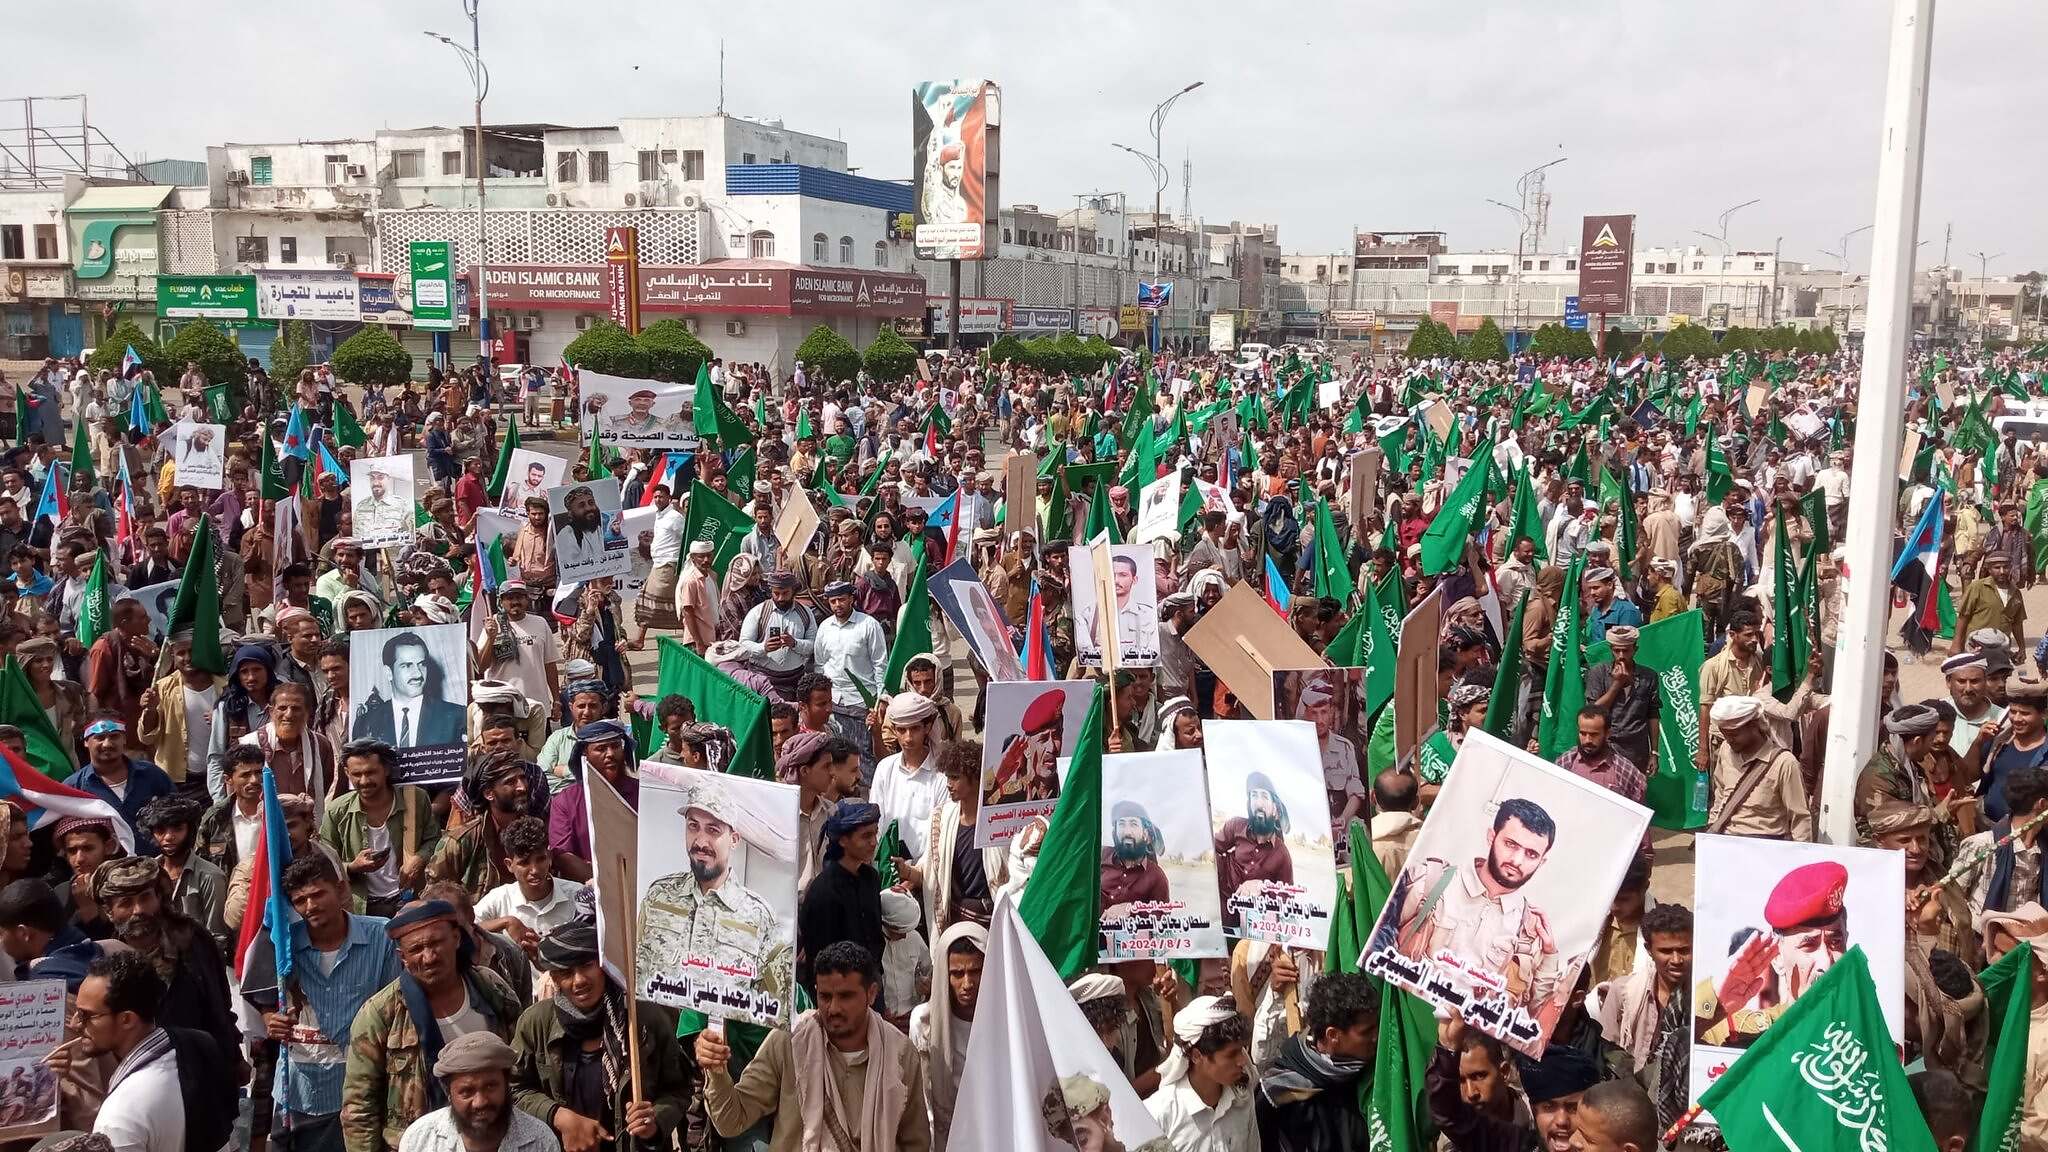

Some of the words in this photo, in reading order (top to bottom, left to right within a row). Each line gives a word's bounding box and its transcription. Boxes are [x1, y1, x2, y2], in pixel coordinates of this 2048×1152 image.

[485, 271, 515, 284] ADEN
[519, 271, 564, 285] ISLAMIC
[566, 272, 600, 285] BANK
[646, 273, 699, 290] الإسلامي
[701, 274, 735, 289] عدن
[737, 272, 772, 291] بنك
[795, 277, 812, 290] ADEN
[813, 279, 836, 292] ISLAMIC
[837, 280, 853, 293] BANK
[271, 285, 310, 302] للتجارة
[315, 287, 354, 305] باعبيد
[529, 289, 544, 298] FOR
[546, 290, 600, 299] MICROFINANCE
[683, 291, 721, 302] للتمويل
[622, 429, 664, 442] الصبيحة
[408, 750, 431, 758] اللطيف
[1303, 903, 1328, 919] سلطان
[1100, 916, 1126, 934] الصبيح
[1183, 915, 1210, 931] سلطان
[1260, 922, 1283, 932] 2024
[1291, 925, 1297, 935] 8
[1305, 928, 1311, 937] 3
[1130, 940, 1157, 948] 2024
[1167, 940, 1174, 948] 8
[1184, 940, 1191, 948] 3
[682, 952, 714, 970] البطل
[717, 956, 757, 978] الشهيد
[1366, 948, 1428, 986] الصبيحي
[647, 972, 691, 999] الصبيحي
[1427, 973, 1467, 1007] سعيد
[693, 982, 719, 1009] علي
[721, 986, 752, 1011] محمد
[752, 993, 780, 1020] صابر
[1464, 994, 1506, 1032] فهمي
[1500, 1008, 1540, 1042] حسام
